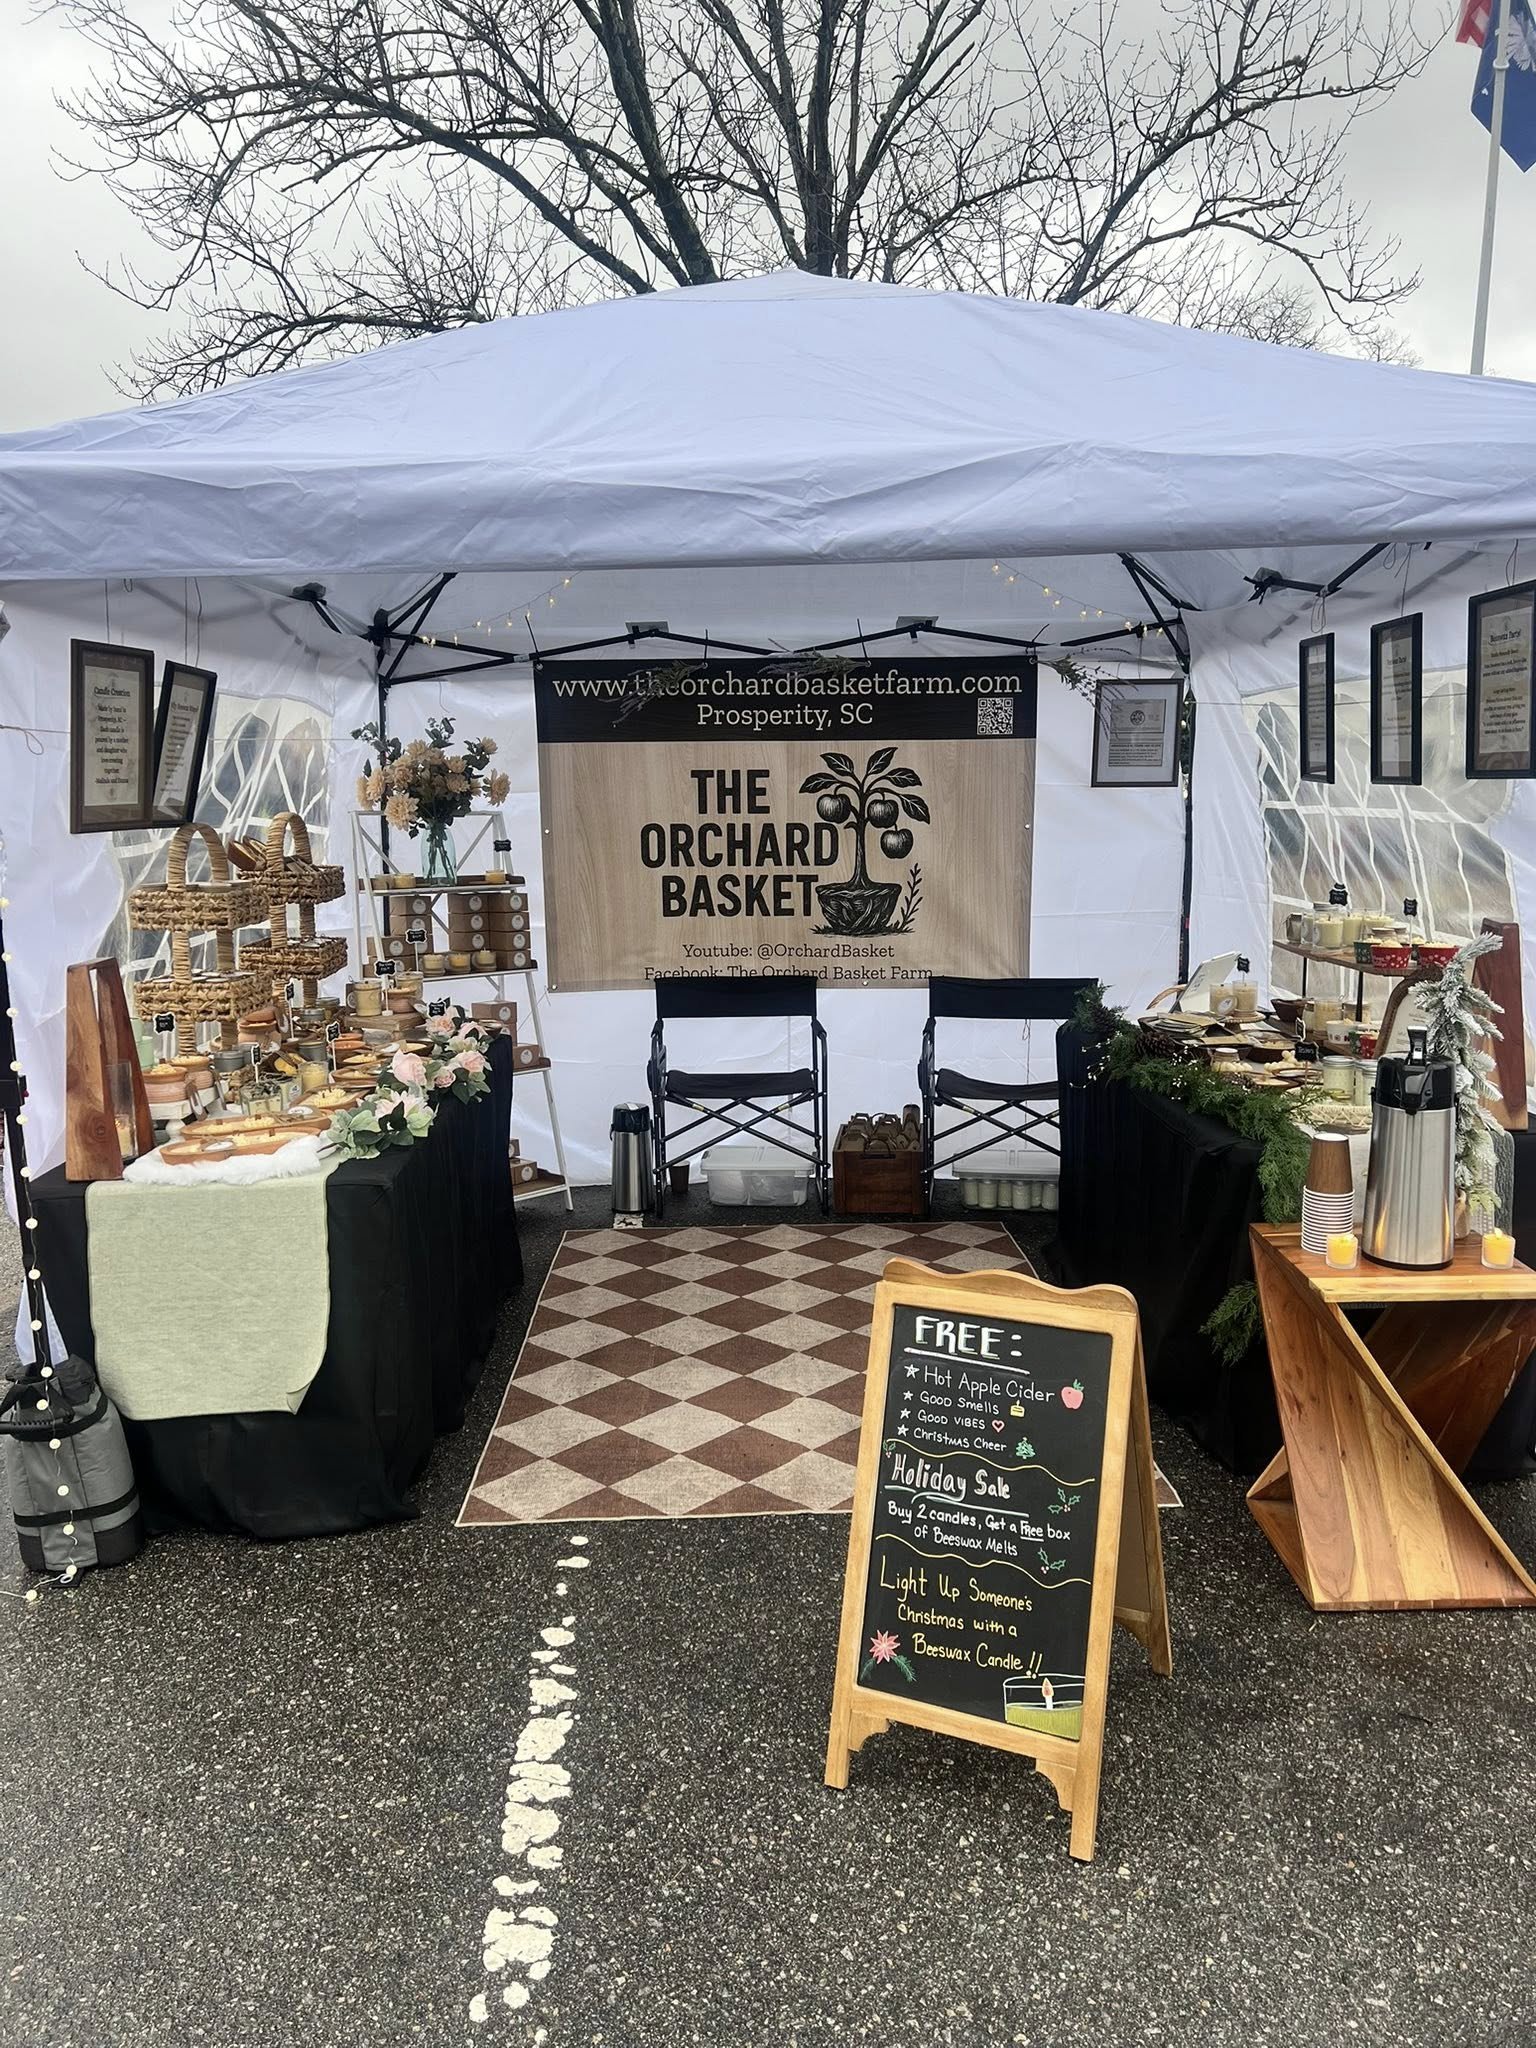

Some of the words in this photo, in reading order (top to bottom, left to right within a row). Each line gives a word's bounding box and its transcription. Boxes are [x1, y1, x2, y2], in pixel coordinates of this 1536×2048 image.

[552, 669, 1023, 698] www.theorchardbasketfarm.com
[697, 703, 832, 732] Prosperity,
[840, 703, 873, 724] SC
[690, 769, 770, 815] THE
[640, 822, 839, 868] ORCHARD
[662, 873, 819, 917] BASKET
[682, 943, 752, 958] Youtube:
[757, 942, 895, 960] @OrchardBasket
[727, 965, 757, 977] The
[762, 965, 828, 980] Orchard
[833, 966, 887, 980] Basket
[891, 966, 933, 980] Farm
[924, 1365, 952, 1388] Hot
[958, 1372, 1001, 1399] Apple
[1006, 1380, 1055, 1402] Cider
[957, 1397, 1000, 1415] Smells
[973, 1437, 1007, 1452] Cheer
[891, 1453, 967, 1502] Holiday
[973, 1469, 1011, 1500] Sale
[887, 1500, 913, 1524] Buy
[916, 1503, 929, 1519] 2
[929, 1511, 982, 1530] candles,
[985, 1514, 1007, 1532] Get
[1009, 1521, 1018, 1533] a
[1047, 1523, 1071, 1541] box
[914, 1525, 929, 1541] of
[932, 1526, 982, 1550] Beeswax
[985, 1538, 1018, 1557] Melts
[880, 1554, 928, 1603] Light
[938, 1573, 961, 1603] Up
[968, 1577, 1033, 1612] Someone's
[897, 1603, 965, 1630] Christmas
[973, 1619, 1005, 1637] with
[1008, 1625, 1018, 1638] a
[911, 1632, 971, 1663] Beeswax
